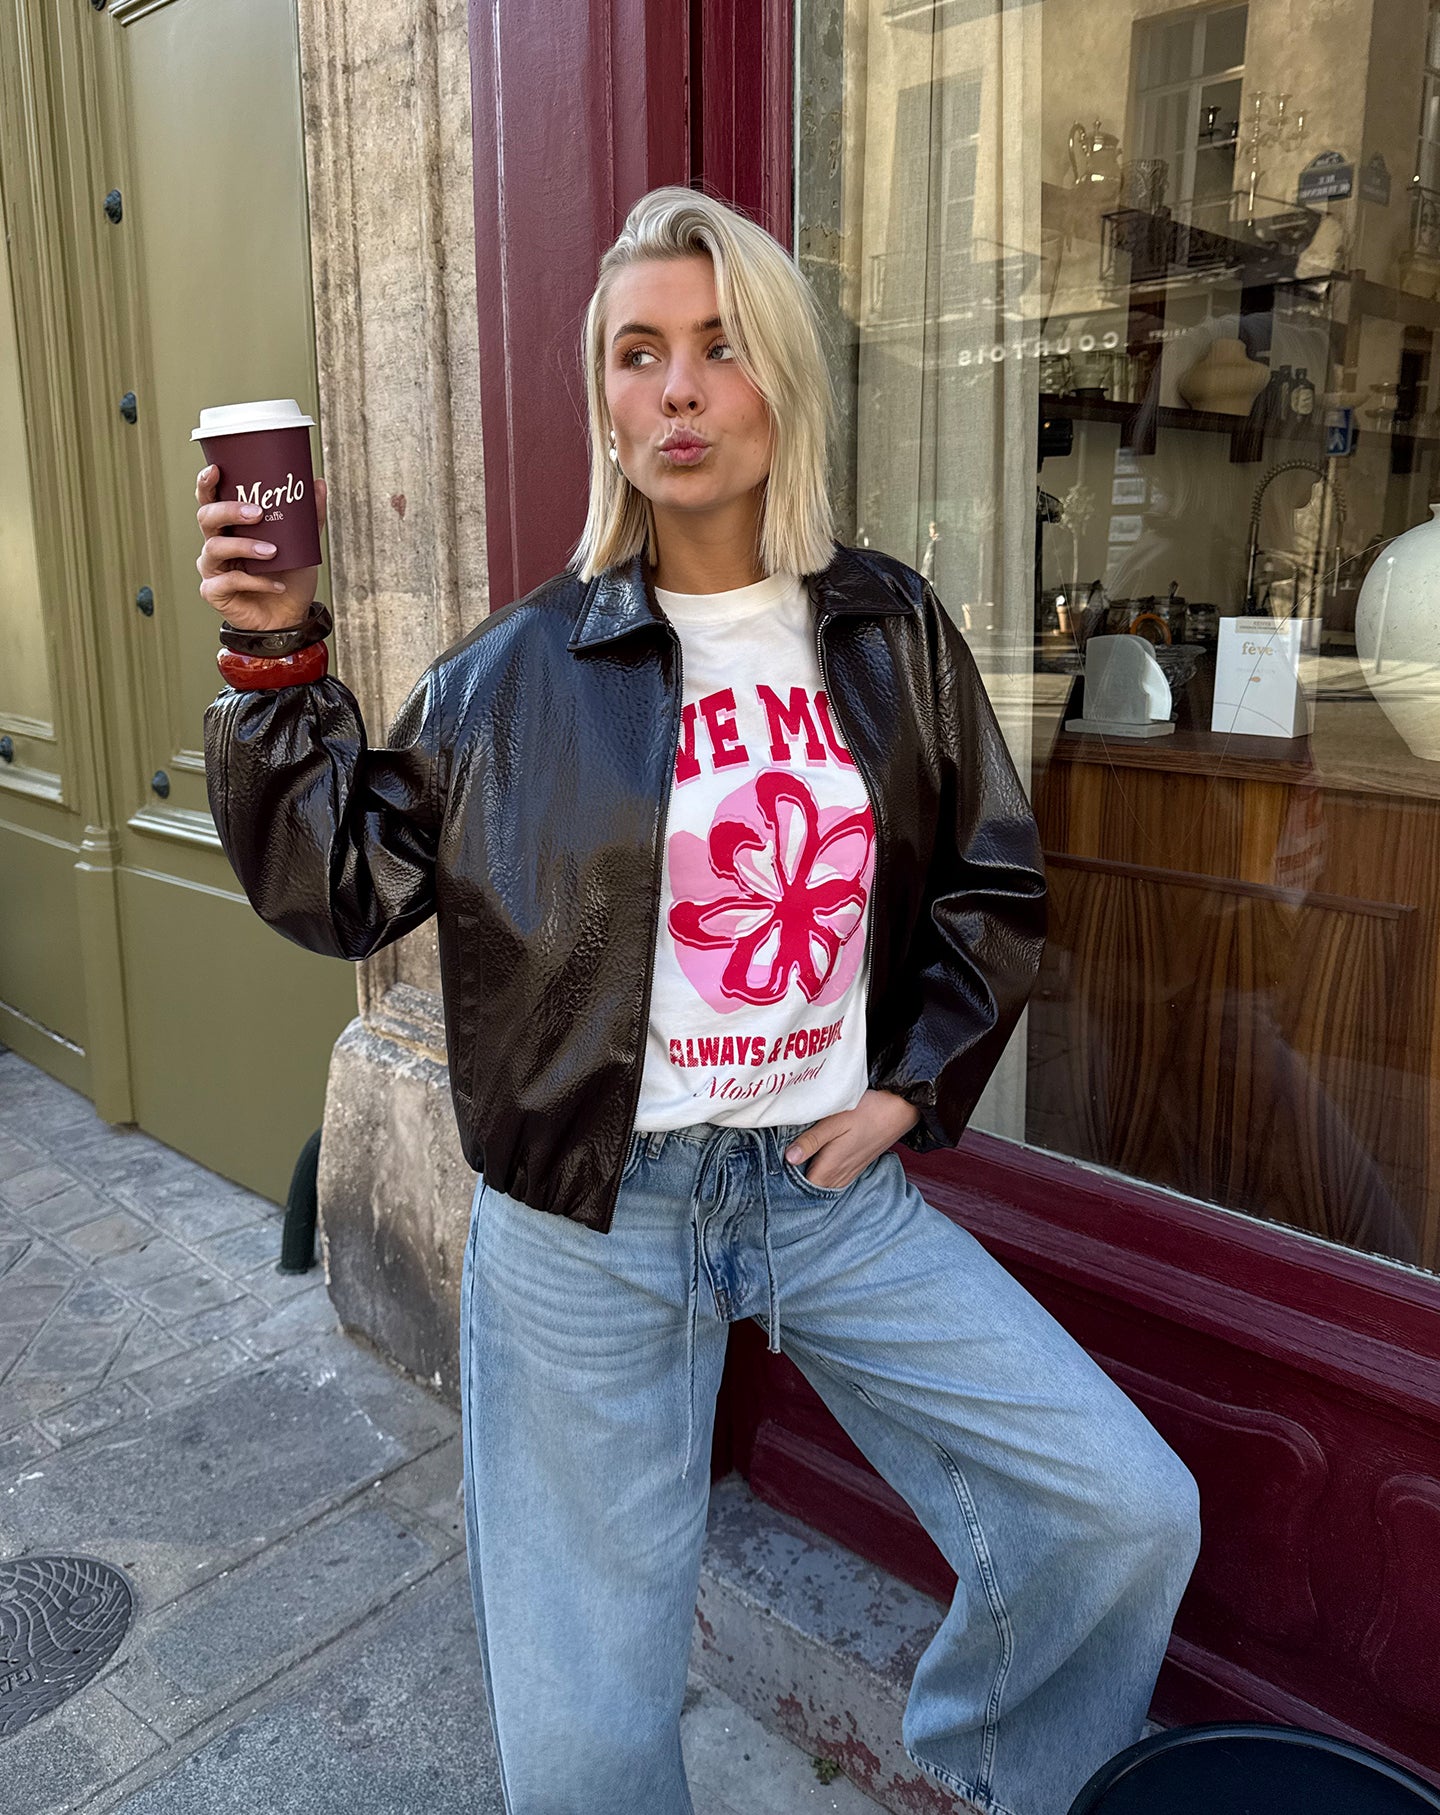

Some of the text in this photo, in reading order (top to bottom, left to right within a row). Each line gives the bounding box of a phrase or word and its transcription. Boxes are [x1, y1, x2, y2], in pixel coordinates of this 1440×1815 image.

[236, 473, 304, 509] Merlo
[265, 511, 284, 522] caffè
[1241, 641, 1273, 655] fève
[669, 1036, 766, 1067] ALWAYS
[767, 1037, 783, 1064] &
[693, 1076, 763, 1101] Most
